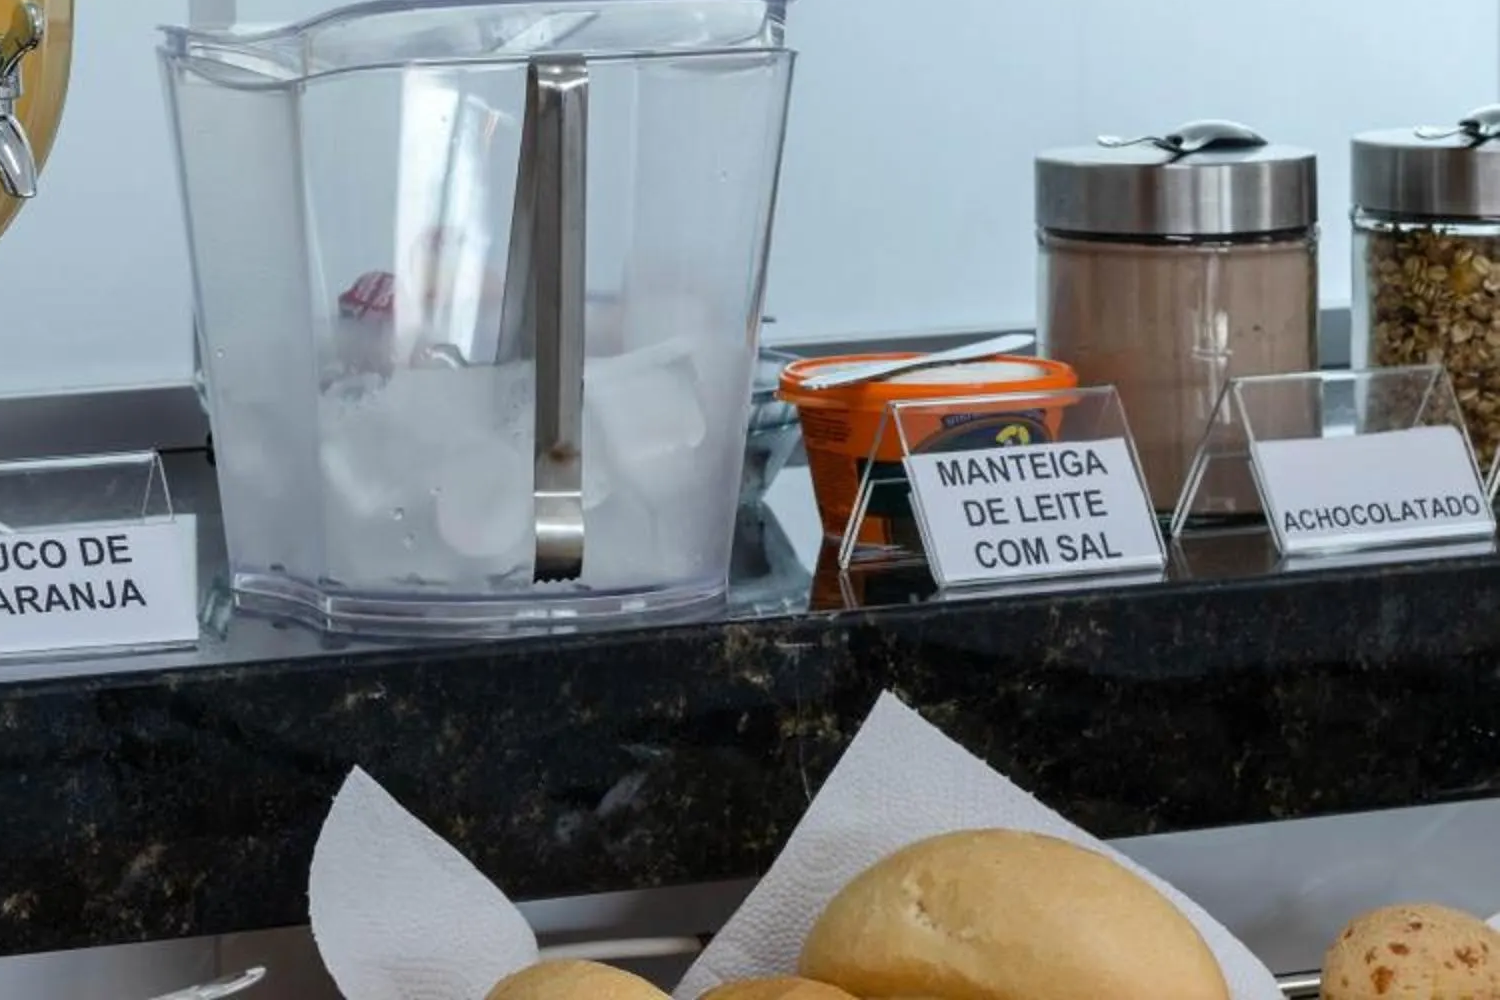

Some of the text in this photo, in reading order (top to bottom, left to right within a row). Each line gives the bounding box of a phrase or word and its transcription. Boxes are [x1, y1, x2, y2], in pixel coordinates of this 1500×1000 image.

[936, 448, 1109, 487] MANTEIGA
[962, 489, 1109, 528] DE LEITE
[1283, 494, 1482, 533] ACHOCOLATADO
[77, 534, 133, 567] DE
[974, 530, 1124, 570] COM SAL
